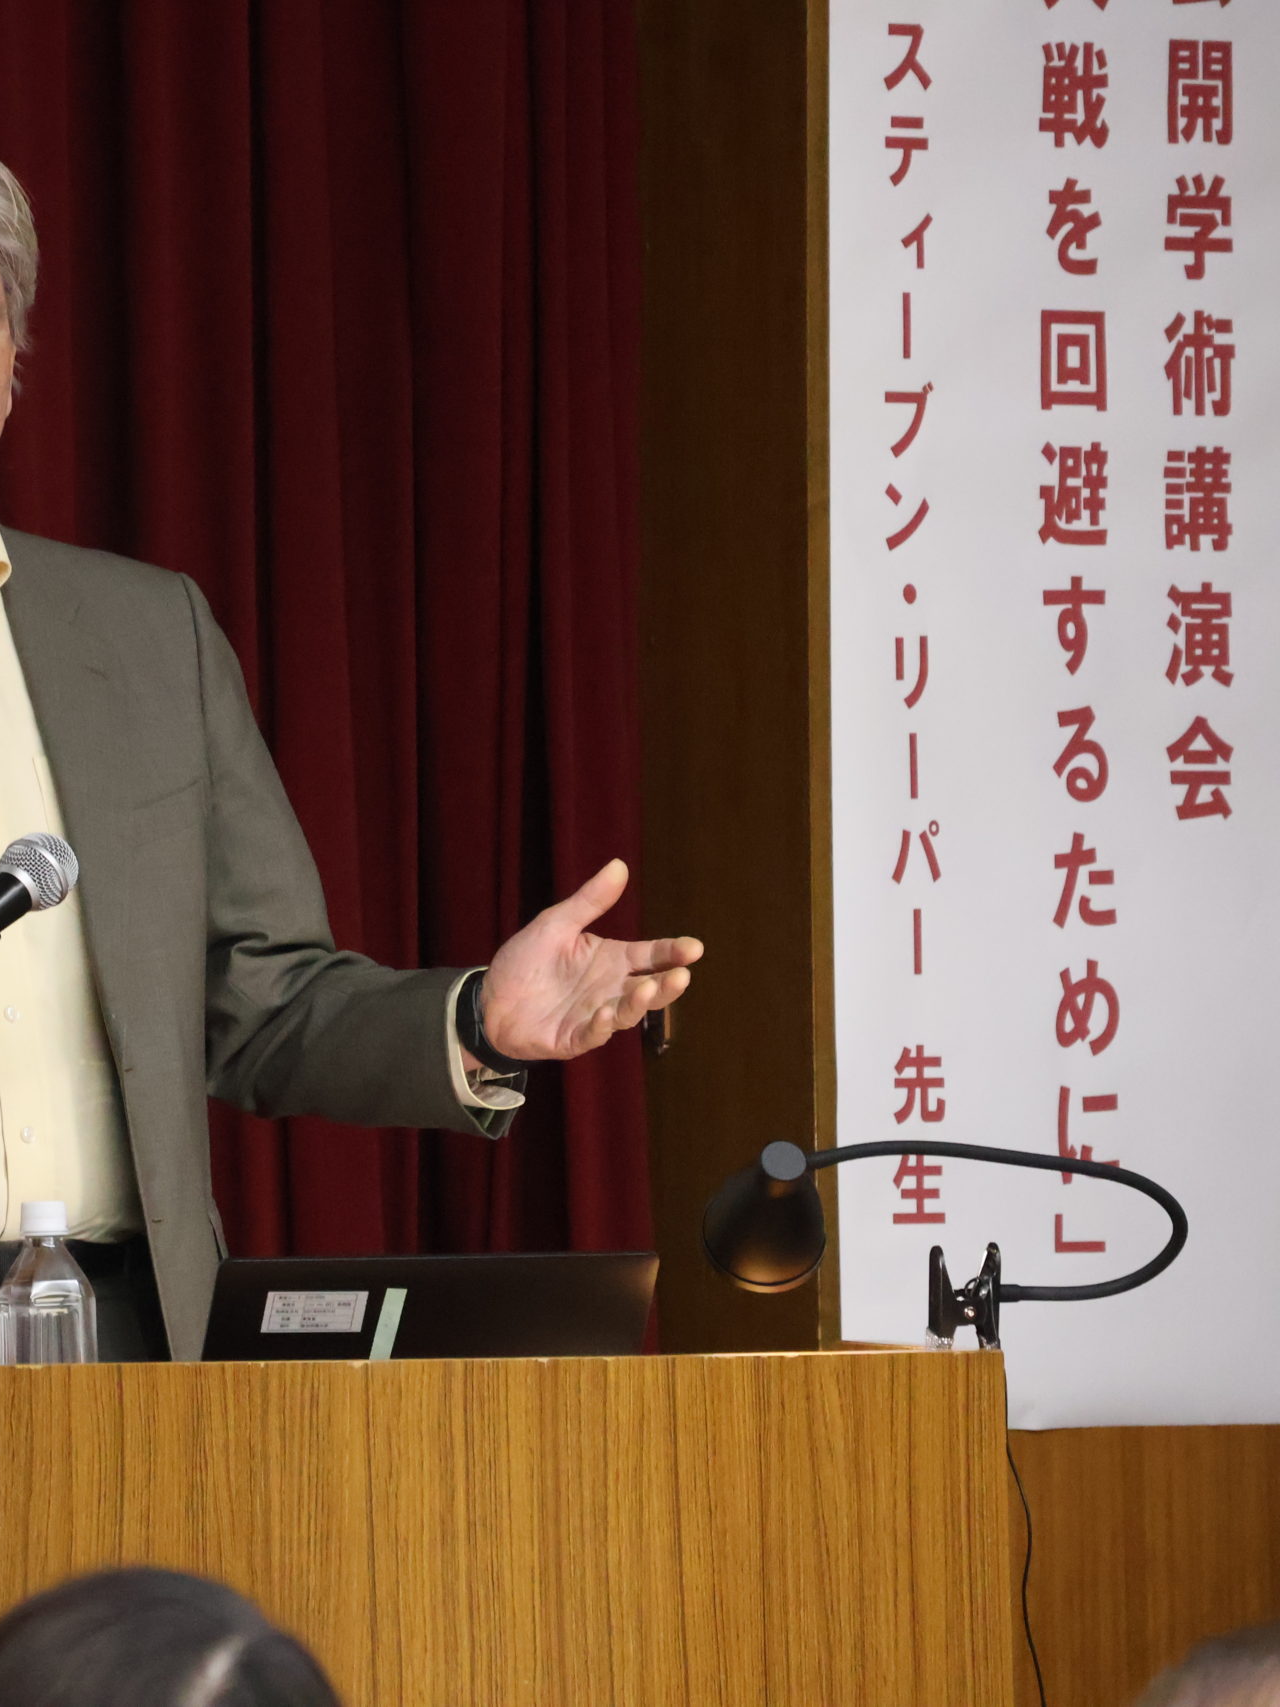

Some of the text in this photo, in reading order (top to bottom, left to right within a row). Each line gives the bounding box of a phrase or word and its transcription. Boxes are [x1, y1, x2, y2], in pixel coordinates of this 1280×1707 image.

[884, 23, 946, 1224] スティーブン・リーパー 先生
[1038, 0, 1120, 1253] 戦を回避するために」
[1163, 0, 1236, 820] 開学術講演会
